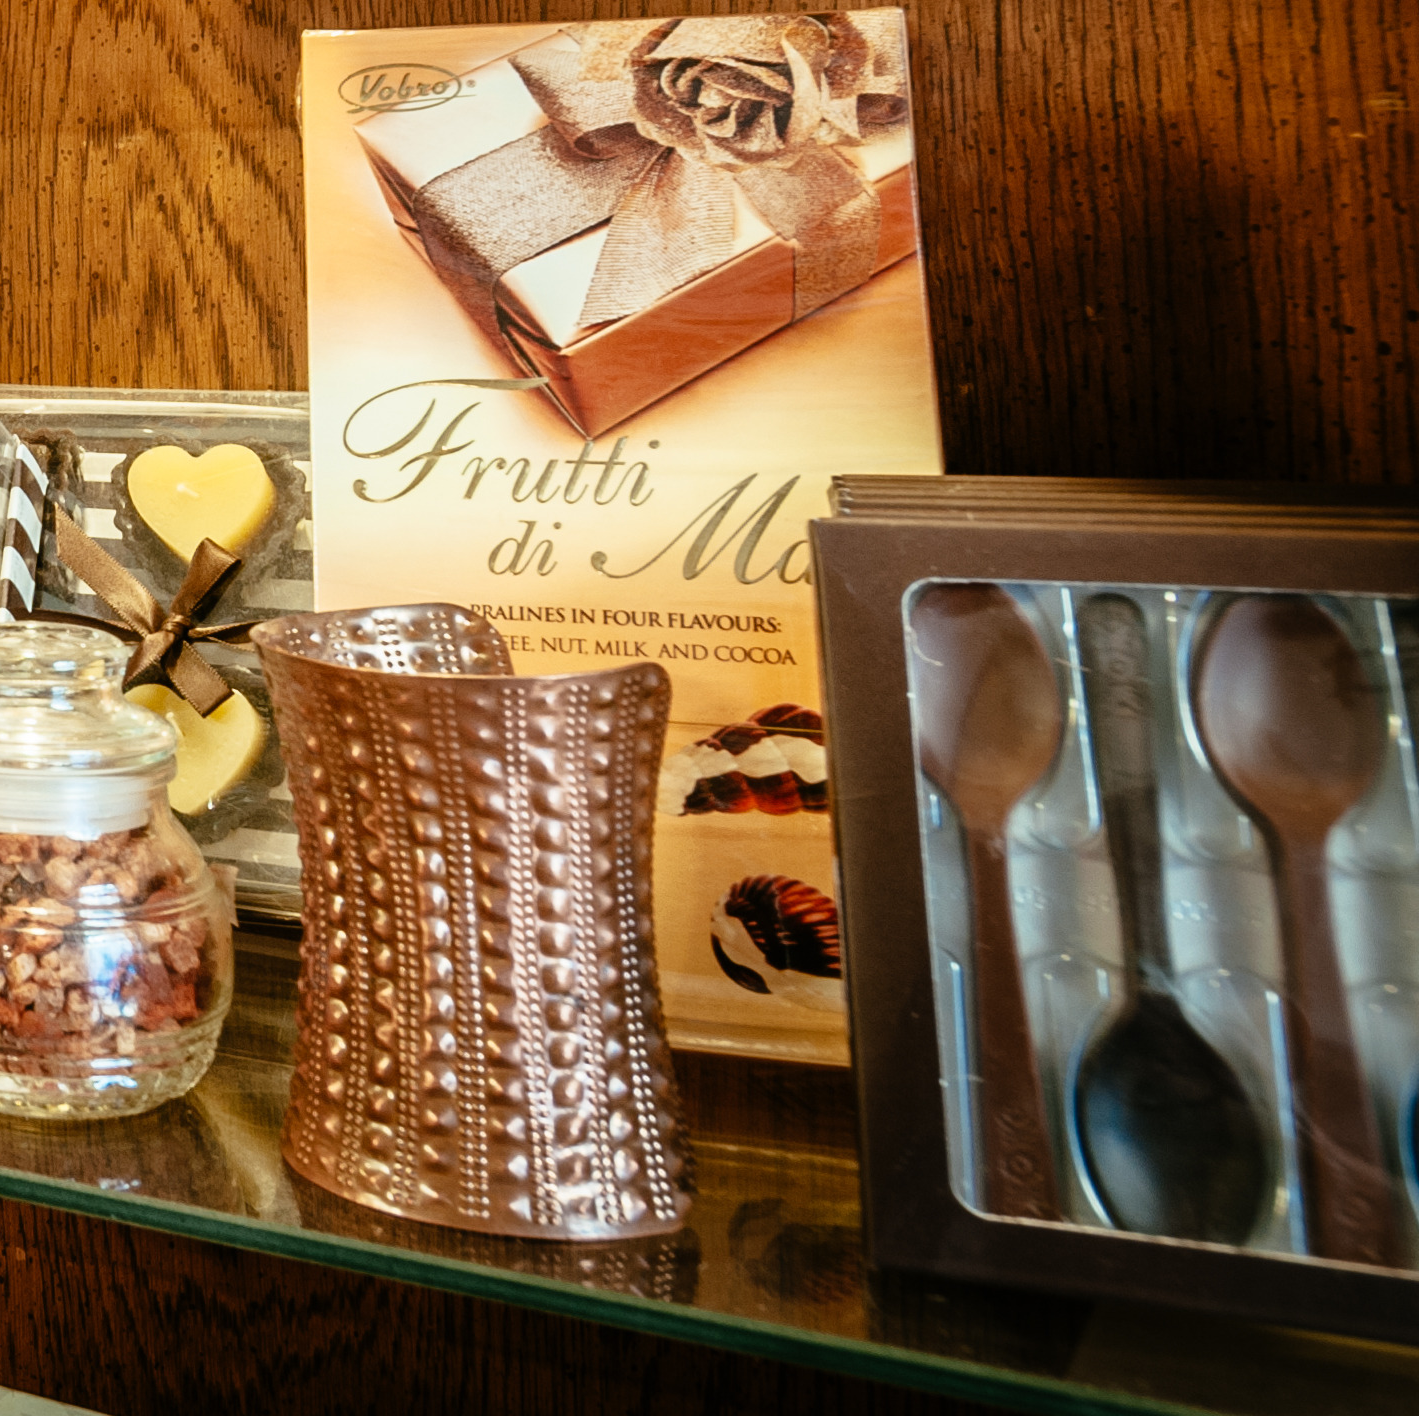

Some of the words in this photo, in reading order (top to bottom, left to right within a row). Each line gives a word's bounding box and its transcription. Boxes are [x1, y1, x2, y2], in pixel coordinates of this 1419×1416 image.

[359, 72, 451, 103] Vobro
[342, 377, 661, 506] Frutti
[487, 519, 563, 577] di
[590, 473, 813, 585] Ma
[470, 603, 565, 624] PRALINES
[571, 608, 596, 625] IN
[602, 608, 663, 629] FOUR
[668, 612, 783, 634] FLAVOURS:
[540, 636, 590, 657] NUT,
[594, 639, 649, 658] MILK
[659, 643, 708, 661] AND
[713, 645, 798, 667] COCOA
